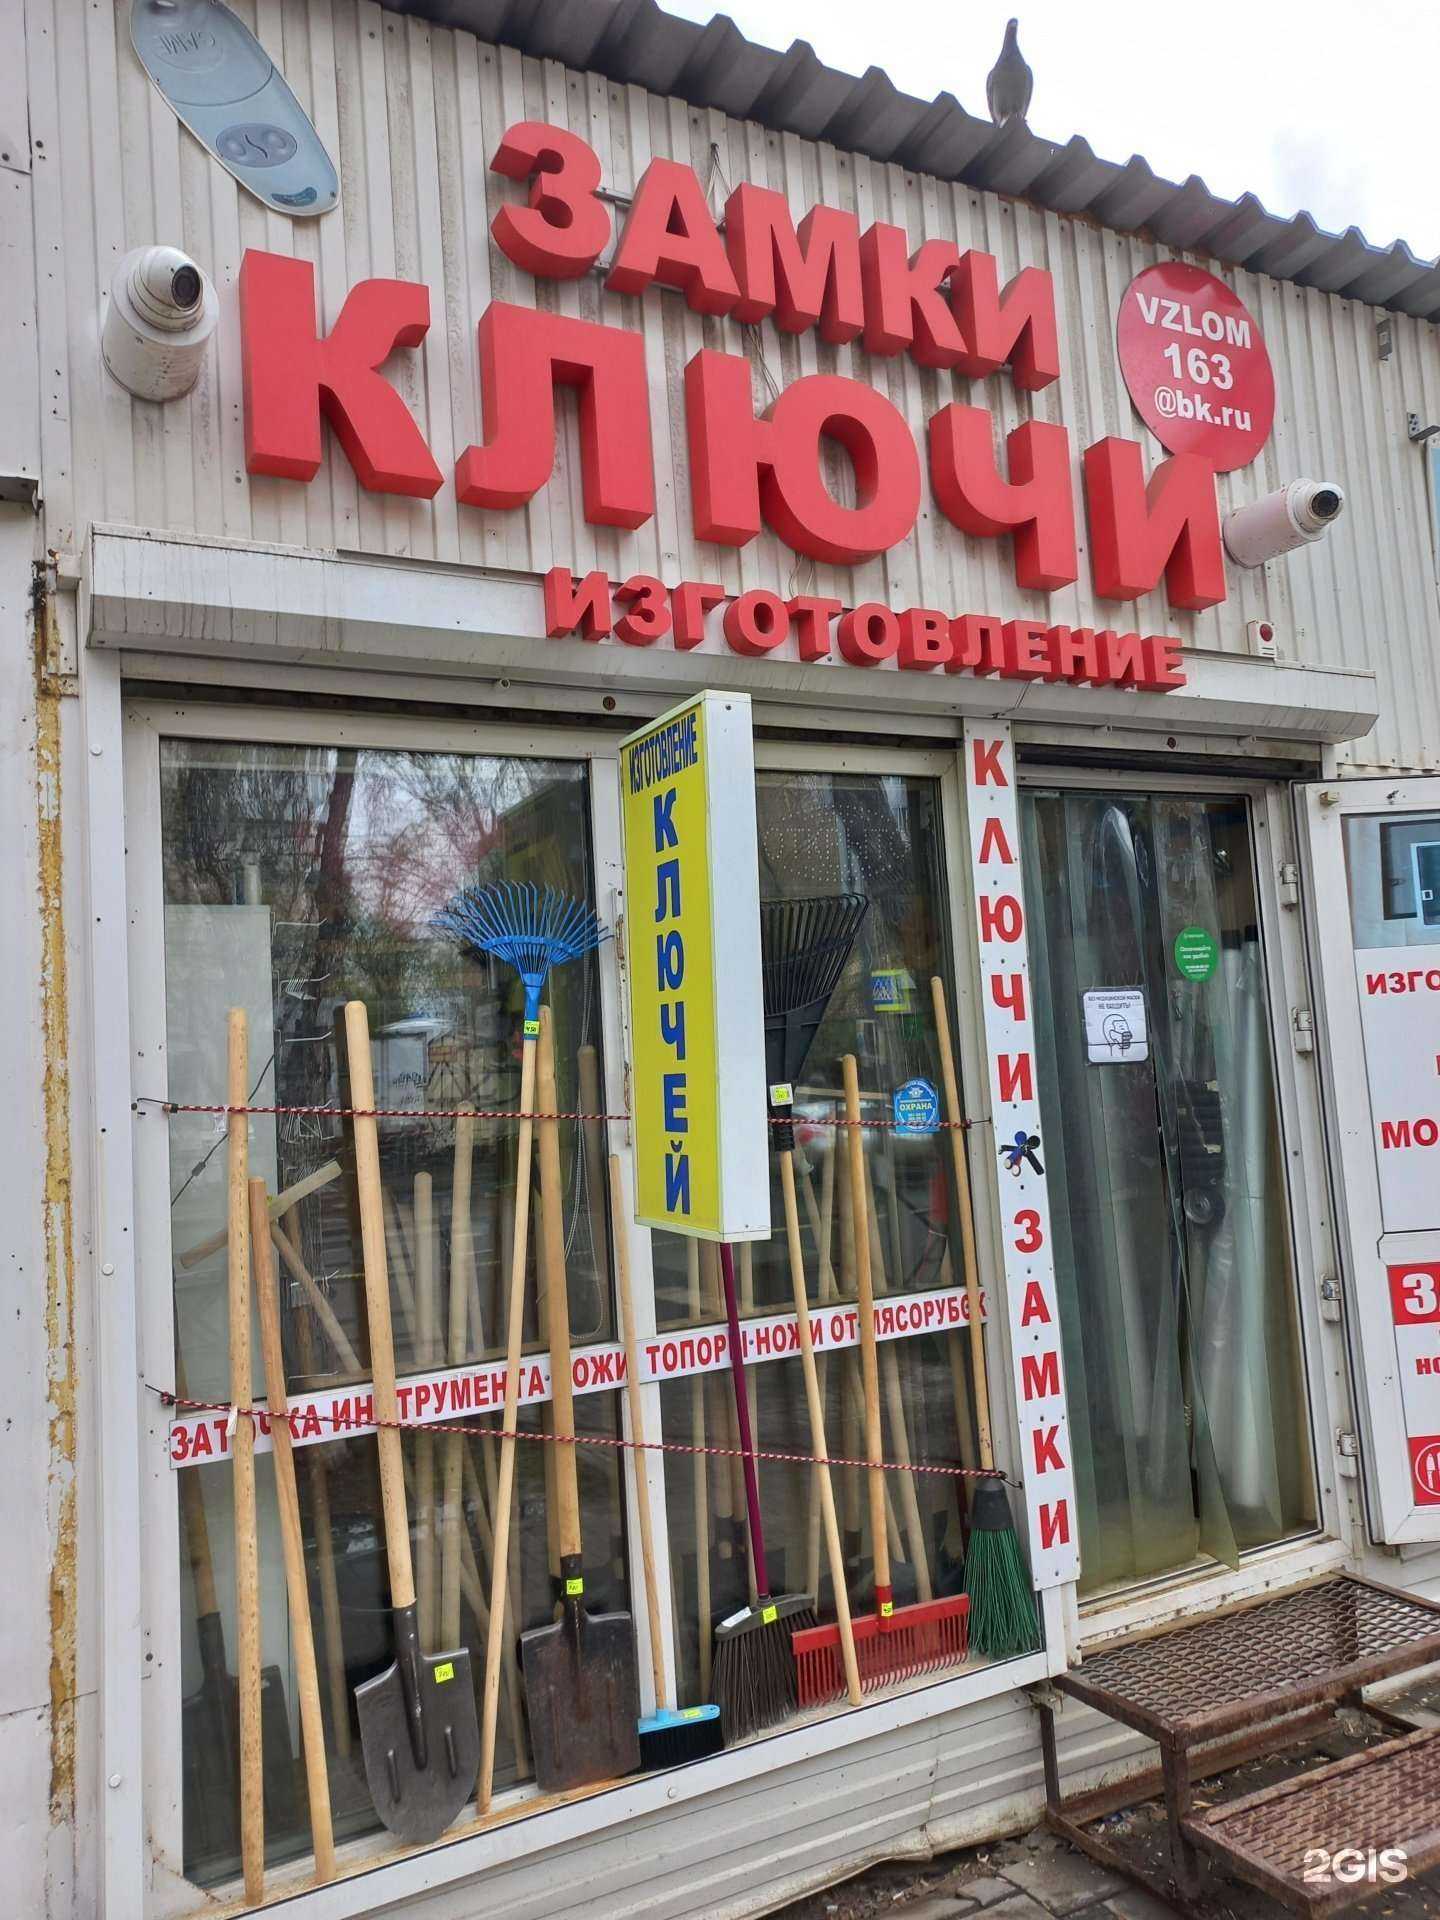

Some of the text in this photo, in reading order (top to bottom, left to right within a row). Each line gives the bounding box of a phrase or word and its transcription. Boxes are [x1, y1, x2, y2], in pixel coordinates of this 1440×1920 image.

[489, 121, 1060, 391] ЗАМКИ
[1136, 292, 1252, 349] VZLOM
[1164, 342, 1234, 390] 163
[239, 248, 1226, 613] КЛЮЧИ
[1154, 386, 1252, 432] @bk.ru
[544, 567, 1187, 692] ИЗГОТОВЛЕНИЕ
[628, 712, 698, 795] ИЗГОТОВЛЕНИЕ
[972, 738, 1034, 1103] КЛЮЧИ
[653, 788, 690, 1216] КЛЮЧЕЙ
[899, 1102, 933, 1111] ОХРАНА
[1402, 1272, 1440, 1315] З
[171, 1404, 322, 1461] ЗАТКА
[332, 1365, 545, 1432] ИНТРУМЕНТА
[571, 1351, 629, 1388] ОЖИ
[830, 1312, 858, 1343] ОТ
[1013, 1209, 1071, 1550] ЗАМКИ
